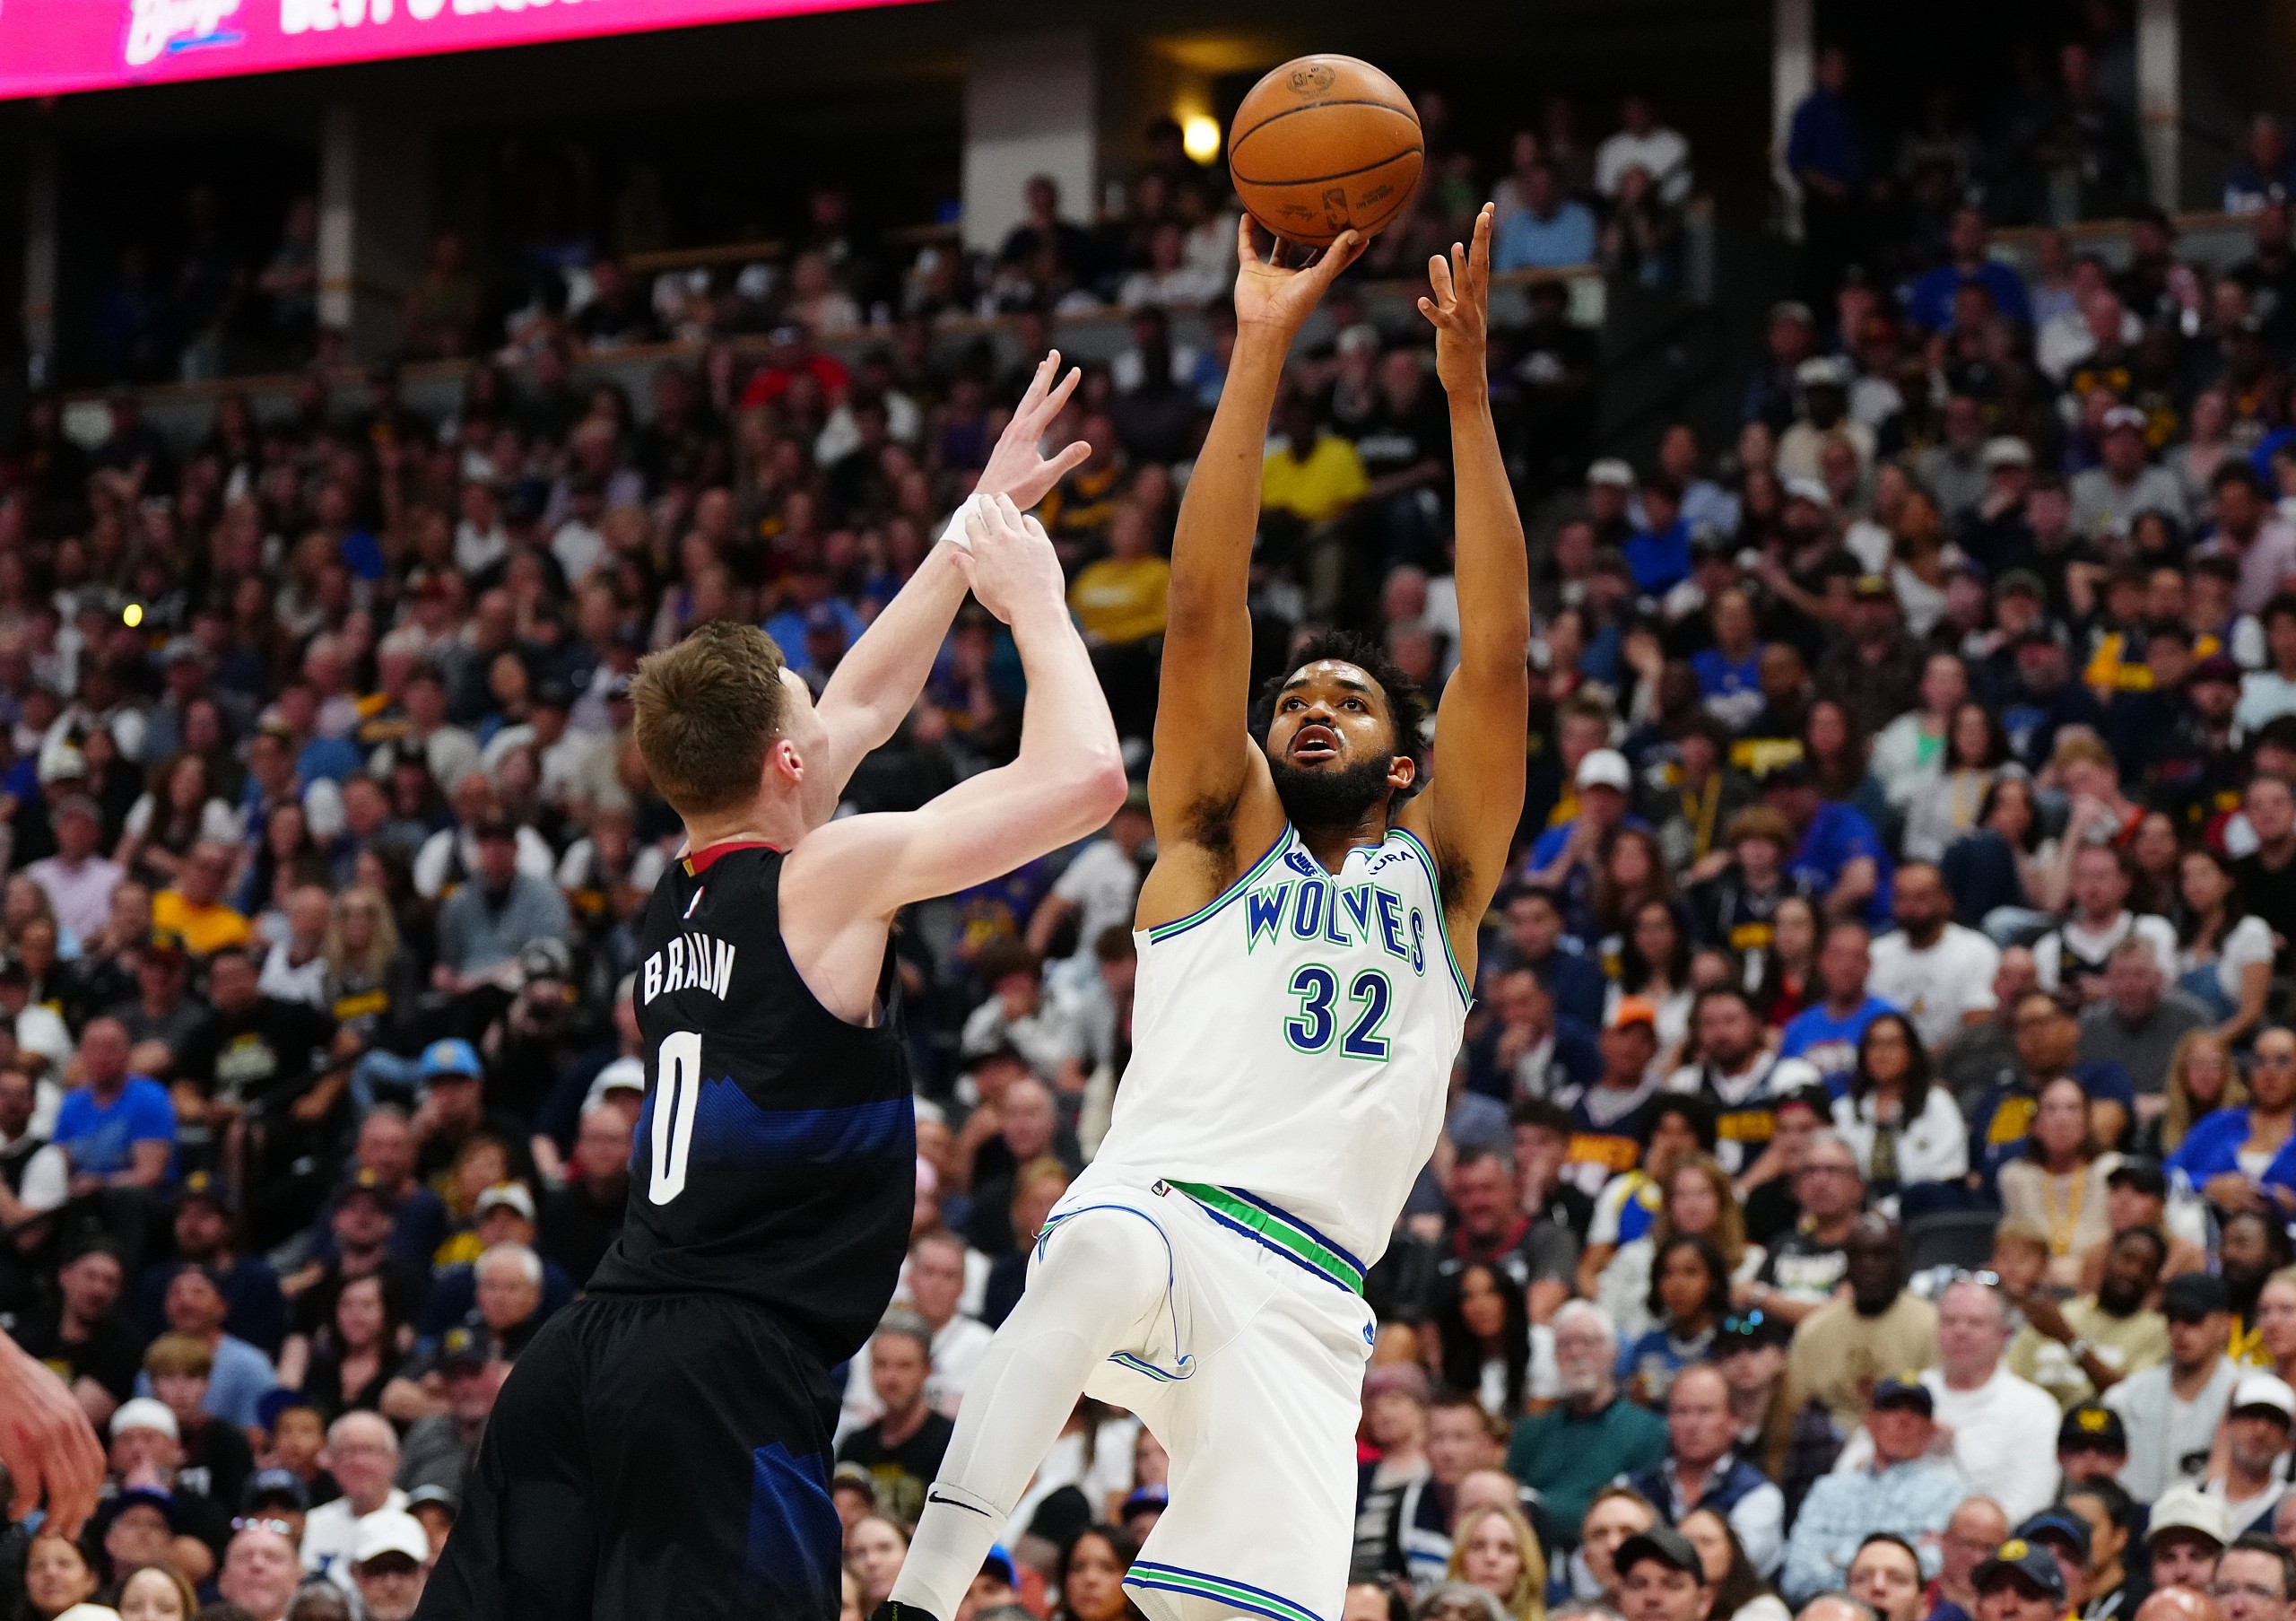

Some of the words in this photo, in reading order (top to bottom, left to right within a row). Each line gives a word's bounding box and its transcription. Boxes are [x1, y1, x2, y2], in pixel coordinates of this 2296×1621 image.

[1293, 852, 1318, 876] NIKE
[1368, 851, 1414, 876] URA
[644, 932, 735, 1006] BRAUN
[1245, 877, 1426, 977] WOLVES
[1283, 963, 1392, 1062] 32
[648, 1031, 701, 1206] 0
